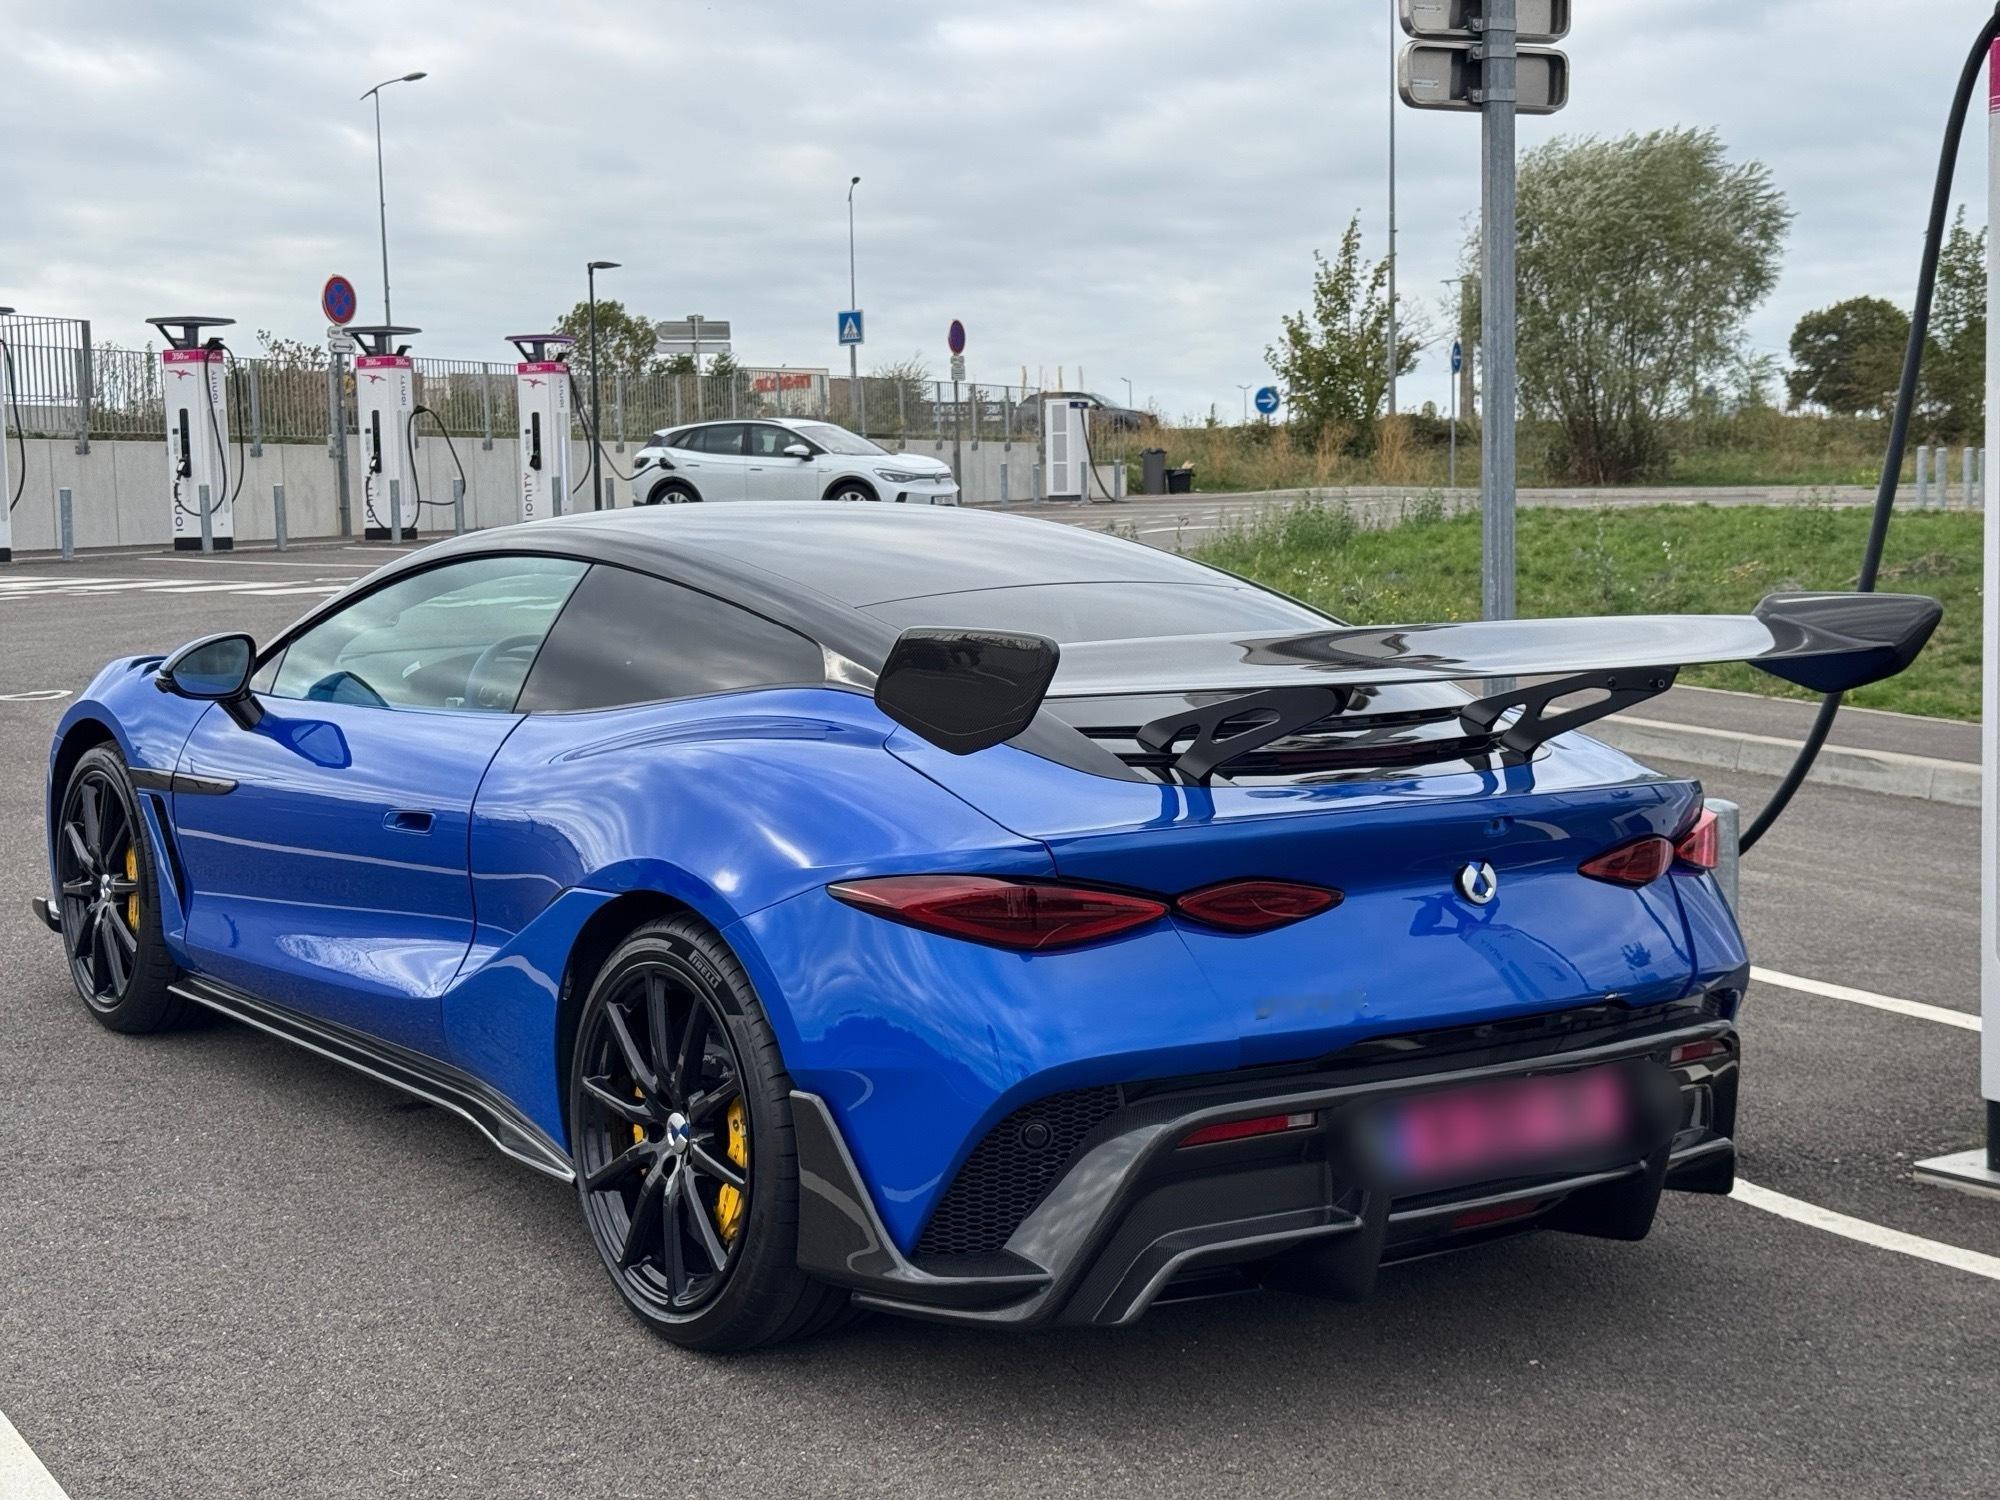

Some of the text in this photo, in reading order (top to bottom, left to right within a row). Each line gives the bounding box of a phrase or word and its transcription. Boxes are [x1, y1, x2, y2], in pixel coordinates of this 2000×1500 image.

[211, 369, 219, 404] IONITY
[524, 472, 534, 516] IONITY
[688, 949, 722, 989] PIRELLI
